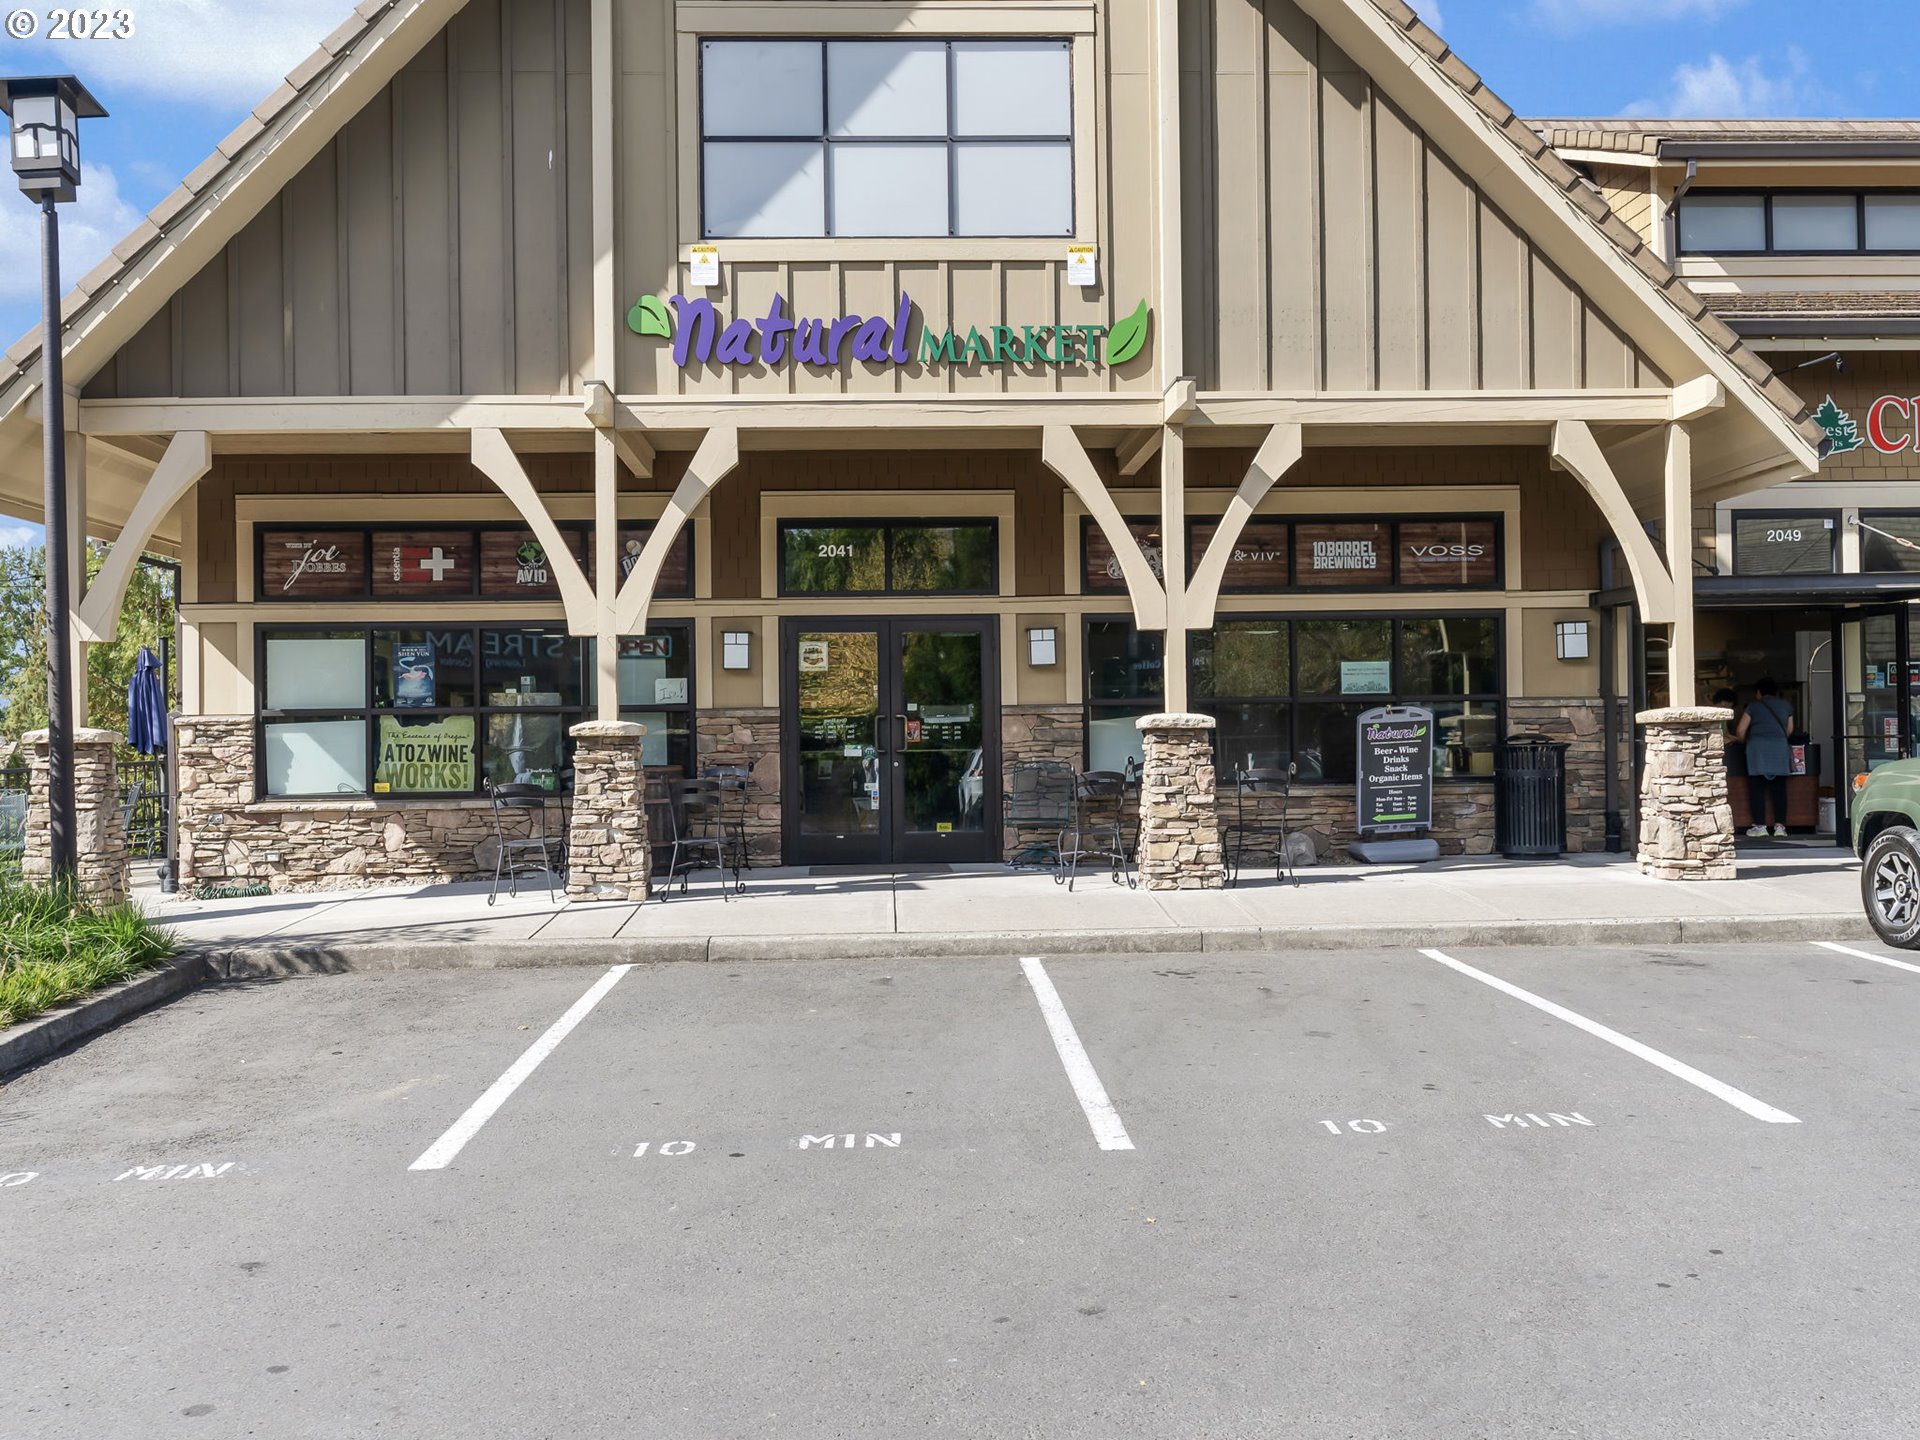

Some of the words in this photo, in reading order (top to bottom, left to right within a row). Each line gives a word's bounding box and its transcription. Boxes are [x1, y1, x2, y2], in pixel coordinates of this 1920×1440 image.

[669, 291, 911, 367] Natural
[917, 324, 1105, 364] MARKET
[1766, 529, 1802, 543] 2049
[818, 544, 854, 558] 2041
[1250, 552, 1275, 561] VIV
[1410, 545, 1483, 556] VOSS
[291, 560, 347, 573] DOBBES
[392, 547, 401, 582] essentia
[516, 569, 547, 584] AVID
[617, 638, 668, 656] PEN
[1366, 724, 1418, 740] Natural
[1374, 747, 1393, 755] Beer
[1399, 746, 1419, 754] Wine
[1383, 755, 1410, 764] Drinks
[1384, 764, 1408, 773] Snack
[384, 763, 468, 789] WORKS!
[1368, 774, 1400, 783] Organic
[1401, 773, 1423, 781] Items
[1318, 1119, 1389, 1134] 10
[1482, 1111, 1597, 1128] MIN
[632, 1140, 697, 1158] 10
[798, 1132, 902, 1149] MIN
[112, 1162, 237, 1181] MIN
